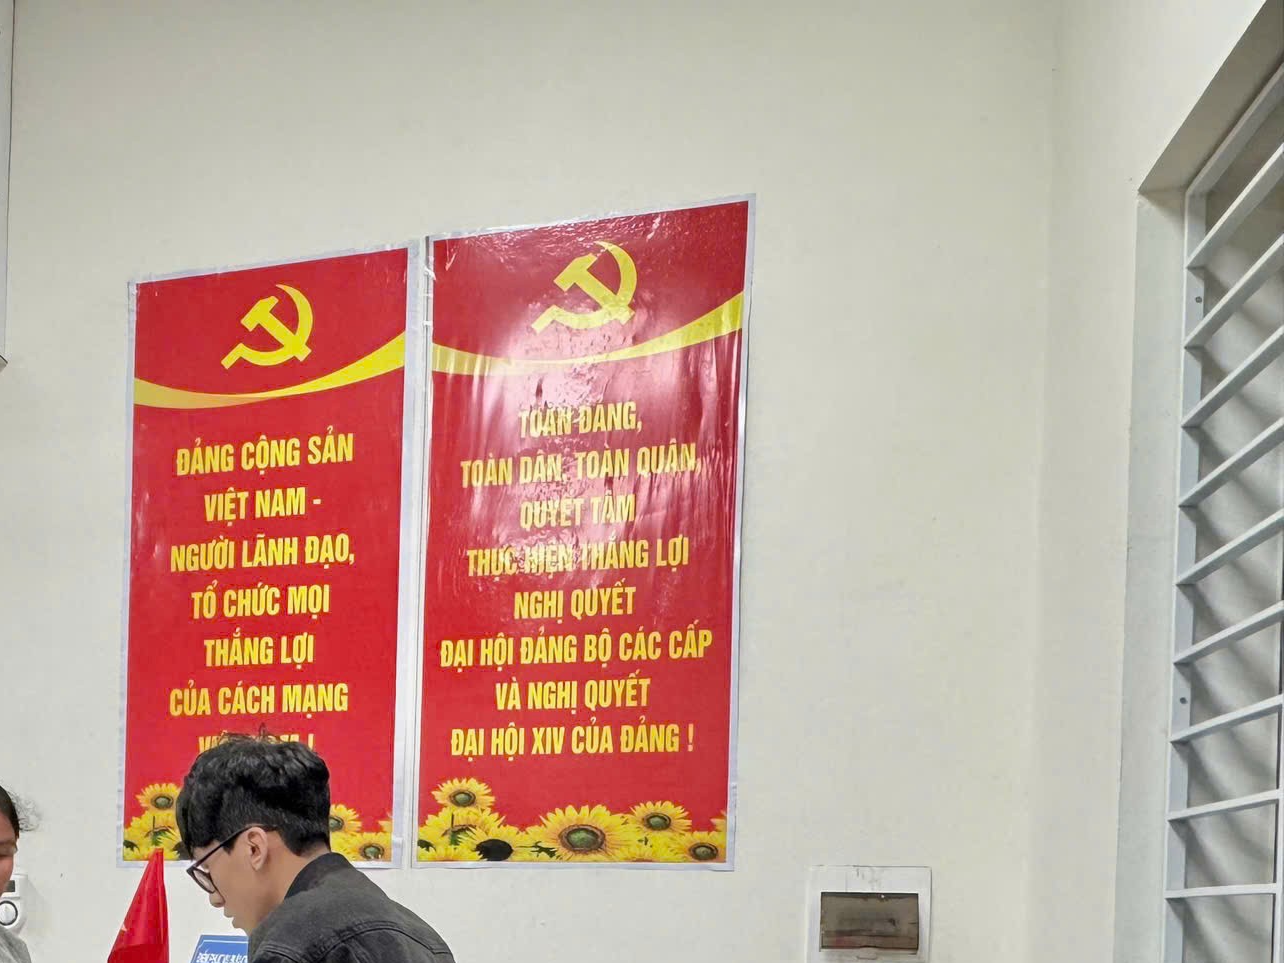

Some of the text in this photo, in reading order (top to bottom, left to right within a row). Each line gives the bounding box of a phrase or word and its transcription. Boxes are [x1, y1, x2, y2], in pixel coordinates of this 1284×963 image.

[176, 425, 354, 476] ĐẢNG CỘNG SẢN
[460, 453, 513, 488] TOÀN
[575, 441, 629, 480] TOÀN
[637, 438, 702, 478] QUÂN,
[204, 486, 249, 526] VIỆT
[255, 487, 306, 518] NAM
[591, 488, 636, 525] TÂM
[170, 533, 355, 573] NGƯỜI LÃNH ĐẠO,
[656, 534, 690, 572] LỢI
[191, 579, 330, 620] TỔ CHỨC MỌI
[514, 577, 636, 624] NGHỊ QUYẾT
[203, 627, 314, 670] THẮNG LỢI
[440, 619, 713, 673] ĐẠI HỘI ĐẢNG BỘ CÁC CẤP
[169, 679, 349, 719] CỦA CÁCH MẠNG
[495, 669, 651, 714] VÀ NGHỊ QUYẾT
[451, 728, 484, 762] ĐẠI
[491, 721, 525, 762] HỘI
[531, 727, 565, 755] XIV
[571, 716, 614, 754] CỦA
[620, 715, 680, 753] ĐẢNG
